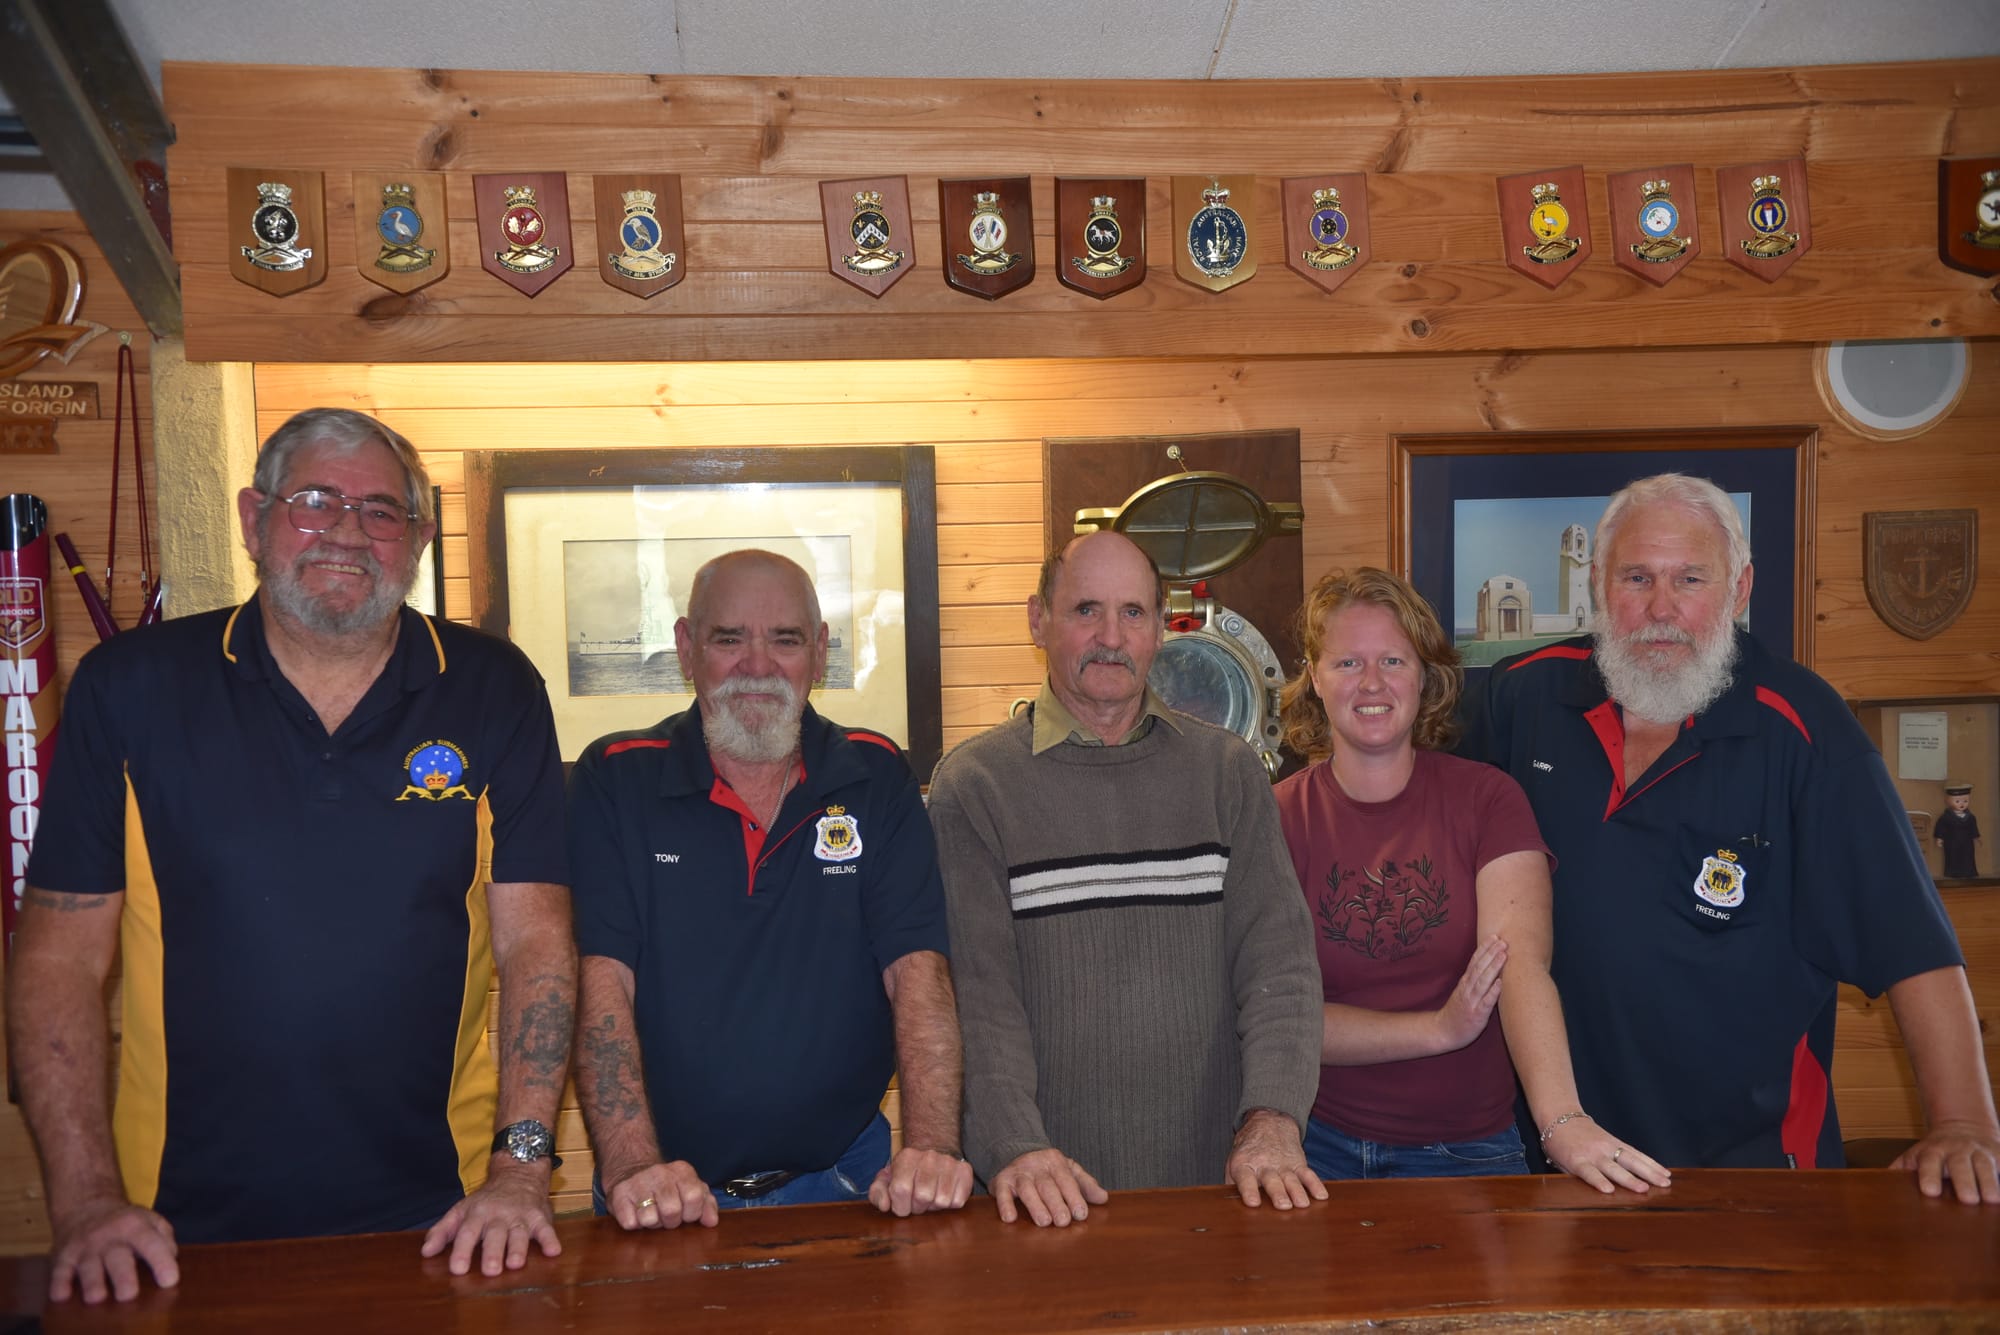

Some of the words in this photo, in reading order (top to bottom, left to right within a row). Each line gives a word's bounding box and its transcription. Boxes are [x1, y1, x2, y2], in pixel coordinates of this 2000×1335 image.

[1197, 209, 1238, 228] AUSTRALIAN
[1193, 236, 1206, 261] ROYAL
[1232, 236, 1242, 258] NAVY
[12, 401, 87, 414] ORIGIN
[655, 853, 681, 864] TONY
[823, 864, 857, 875] FREELING
[1695, 903, 1731, 921] FREELING
